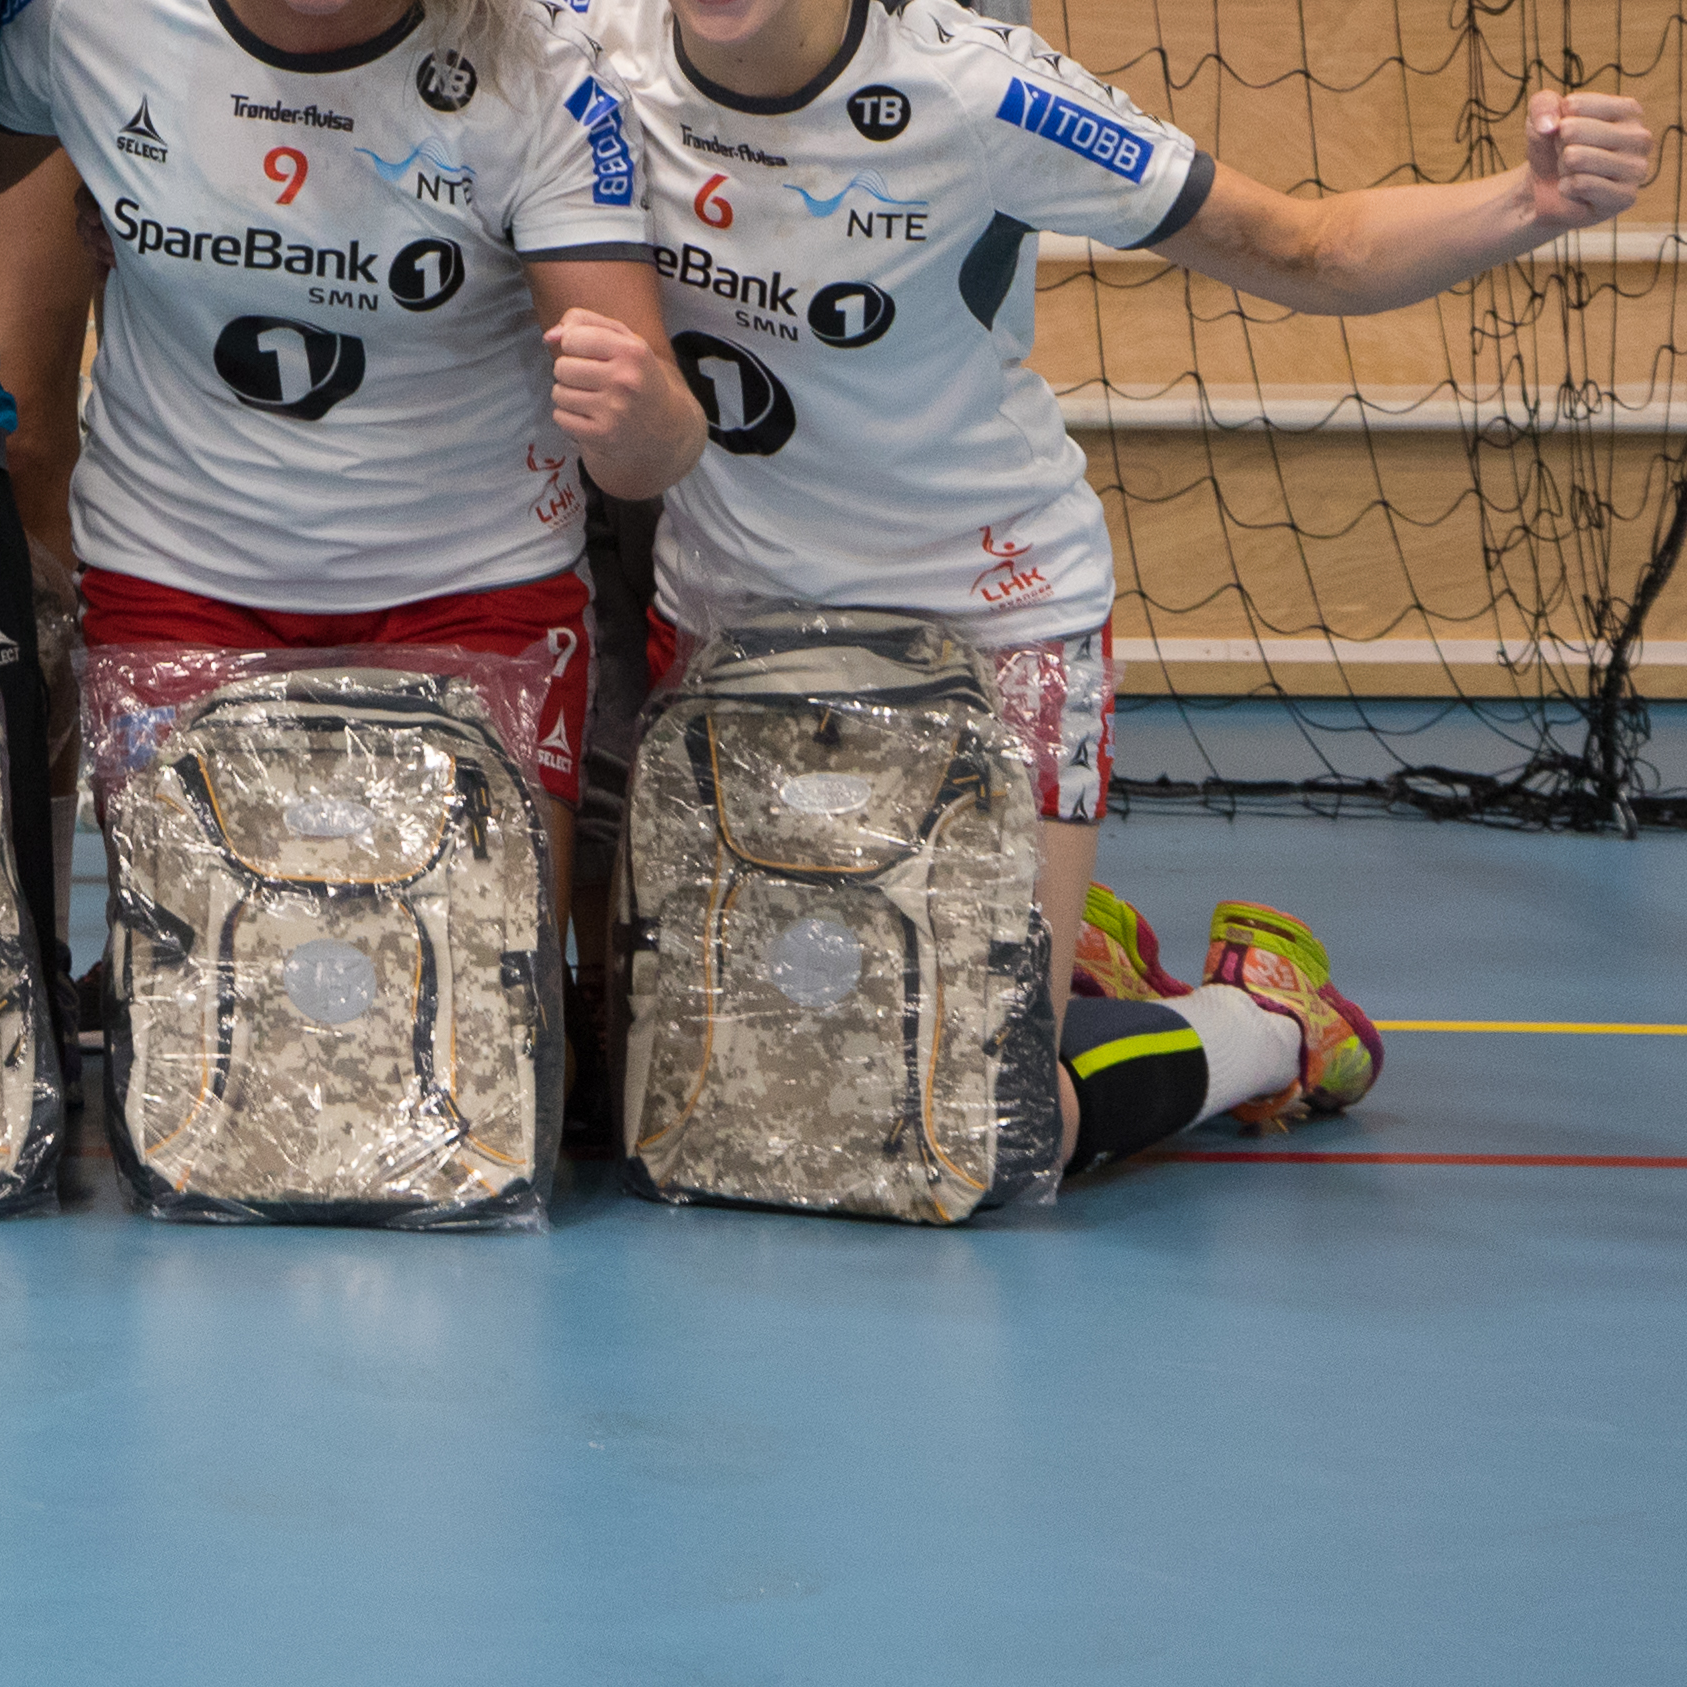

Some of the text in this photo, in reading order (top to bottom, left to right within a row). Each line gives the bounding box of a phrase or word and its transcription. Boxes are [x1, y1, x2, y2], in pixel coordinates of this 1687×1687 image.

[854, 95, 903, 124] TB
[116, 136, 168, 163] SELECT
[591, 111, 628, 196] TOBB
[1055, 105, 1143, 173] TOBB
[263, 146, 309, 205] 9
[693, 174, 733, 229] 6
[113, 198, 379, 284] SpareBank
[847, 209, 927, 241] NTE
[308, 287, 379, 311] SMN
[655, 243, 798, 317] eBank
[735, 310, 800, 341] SMN
[981, 567, 1046, 602] LHK
[546, 625, 579, 678] 9
[537, 749, 574, 775] SELECT
